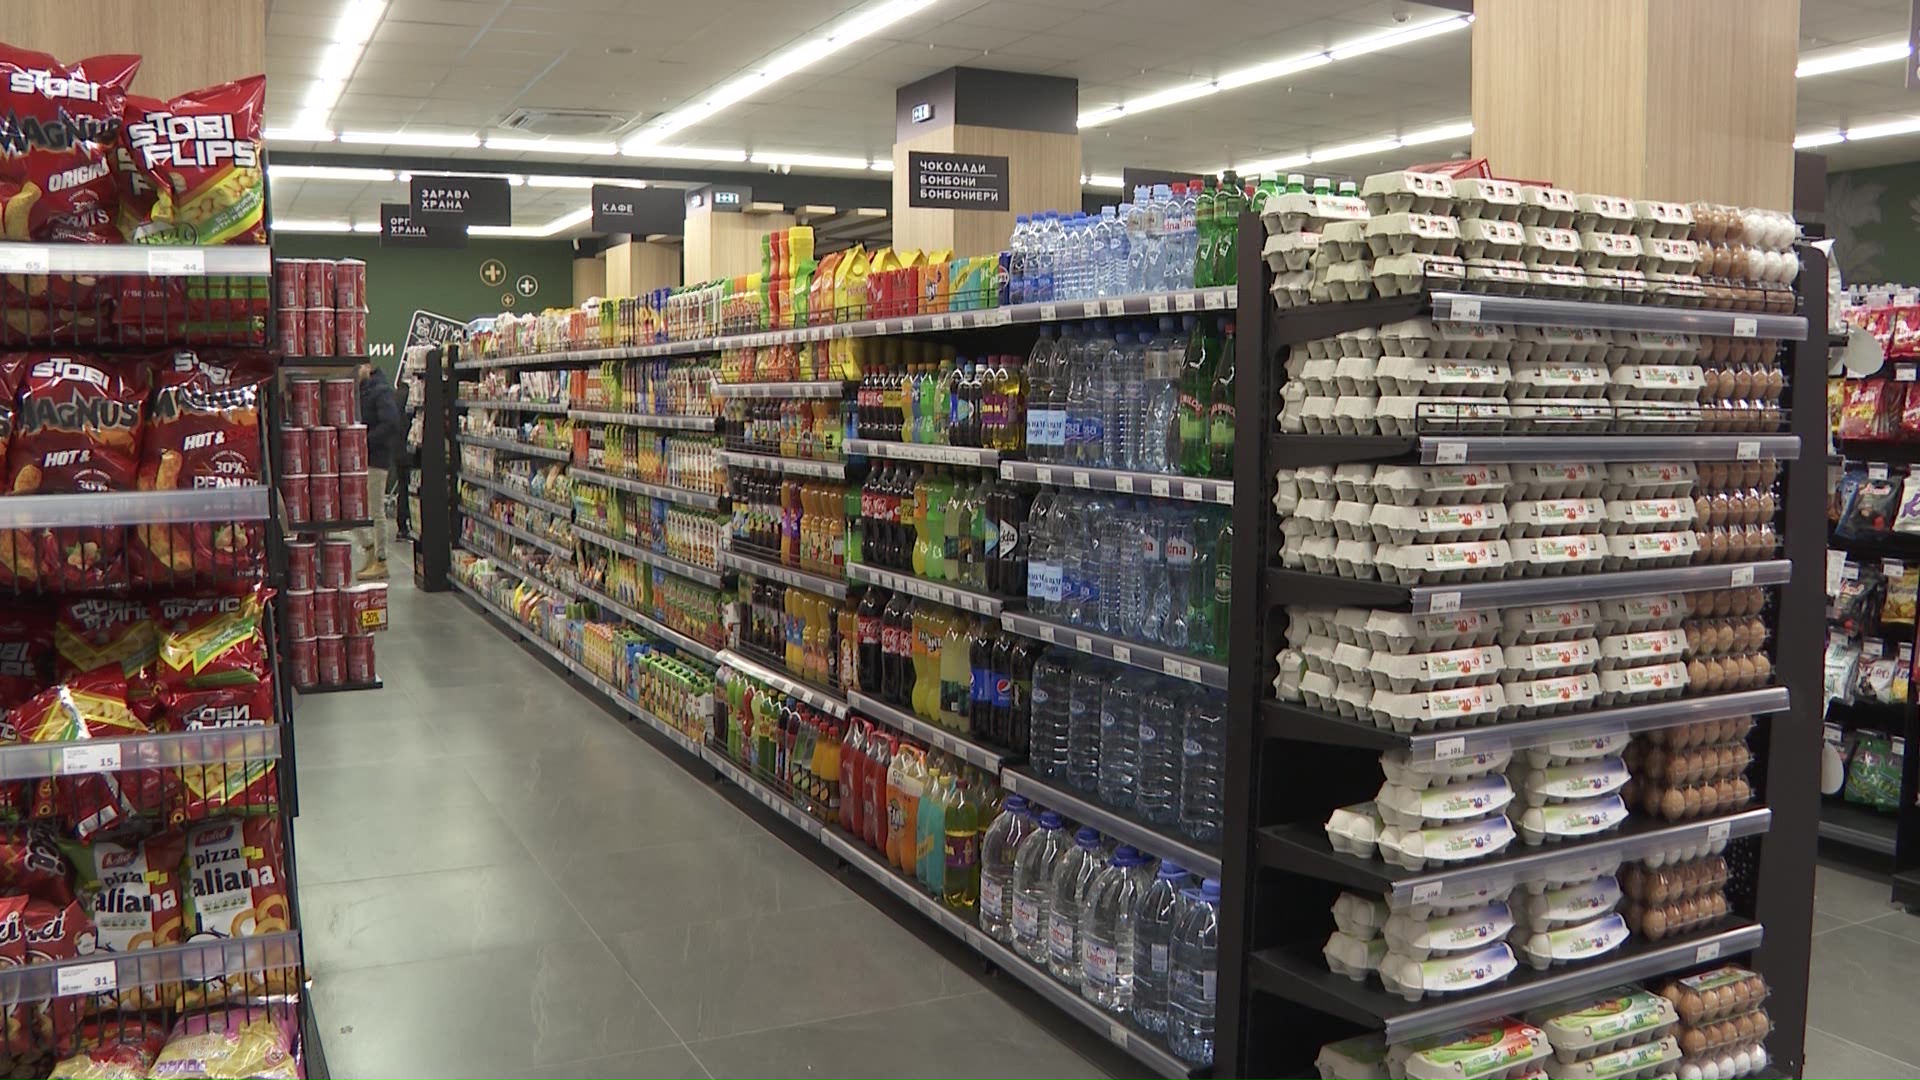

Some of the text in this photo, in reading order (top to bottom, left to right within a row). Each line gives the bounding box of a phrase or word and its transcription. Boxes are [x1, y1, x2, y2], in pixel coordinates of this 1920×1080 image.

[10, 69, 98, 101] STOBI
[129, 112, 235, 148] STOBI
[143, 140, 256, 170] FLIPS
[919, 160, 986, 174] ЧОКОЛАДИ
[919, 175, 976, 188] БОНБОНИ
[421, 188, 471, 200] ЗДРАВА
[919, 188, 999, 202] БОНБОНИЕРИ
[421, 200, 463, 210] ХРАНА
[602, 202, 634, 213] КАФЕ
[390, 226, 427, 236] ХРАНА
[369, 343, 395, 356] ИИ
[32, 358, 110, 390] STOBI
[184, 431, 225, 450] HOT &
[44, 449, 91, 467] HOT &
[215, 462, 245, 474] 30%
[100, 757, 114, 768] 15
[195, 847, 241, 869] pizza
[94, 976, 108, 987] 31
